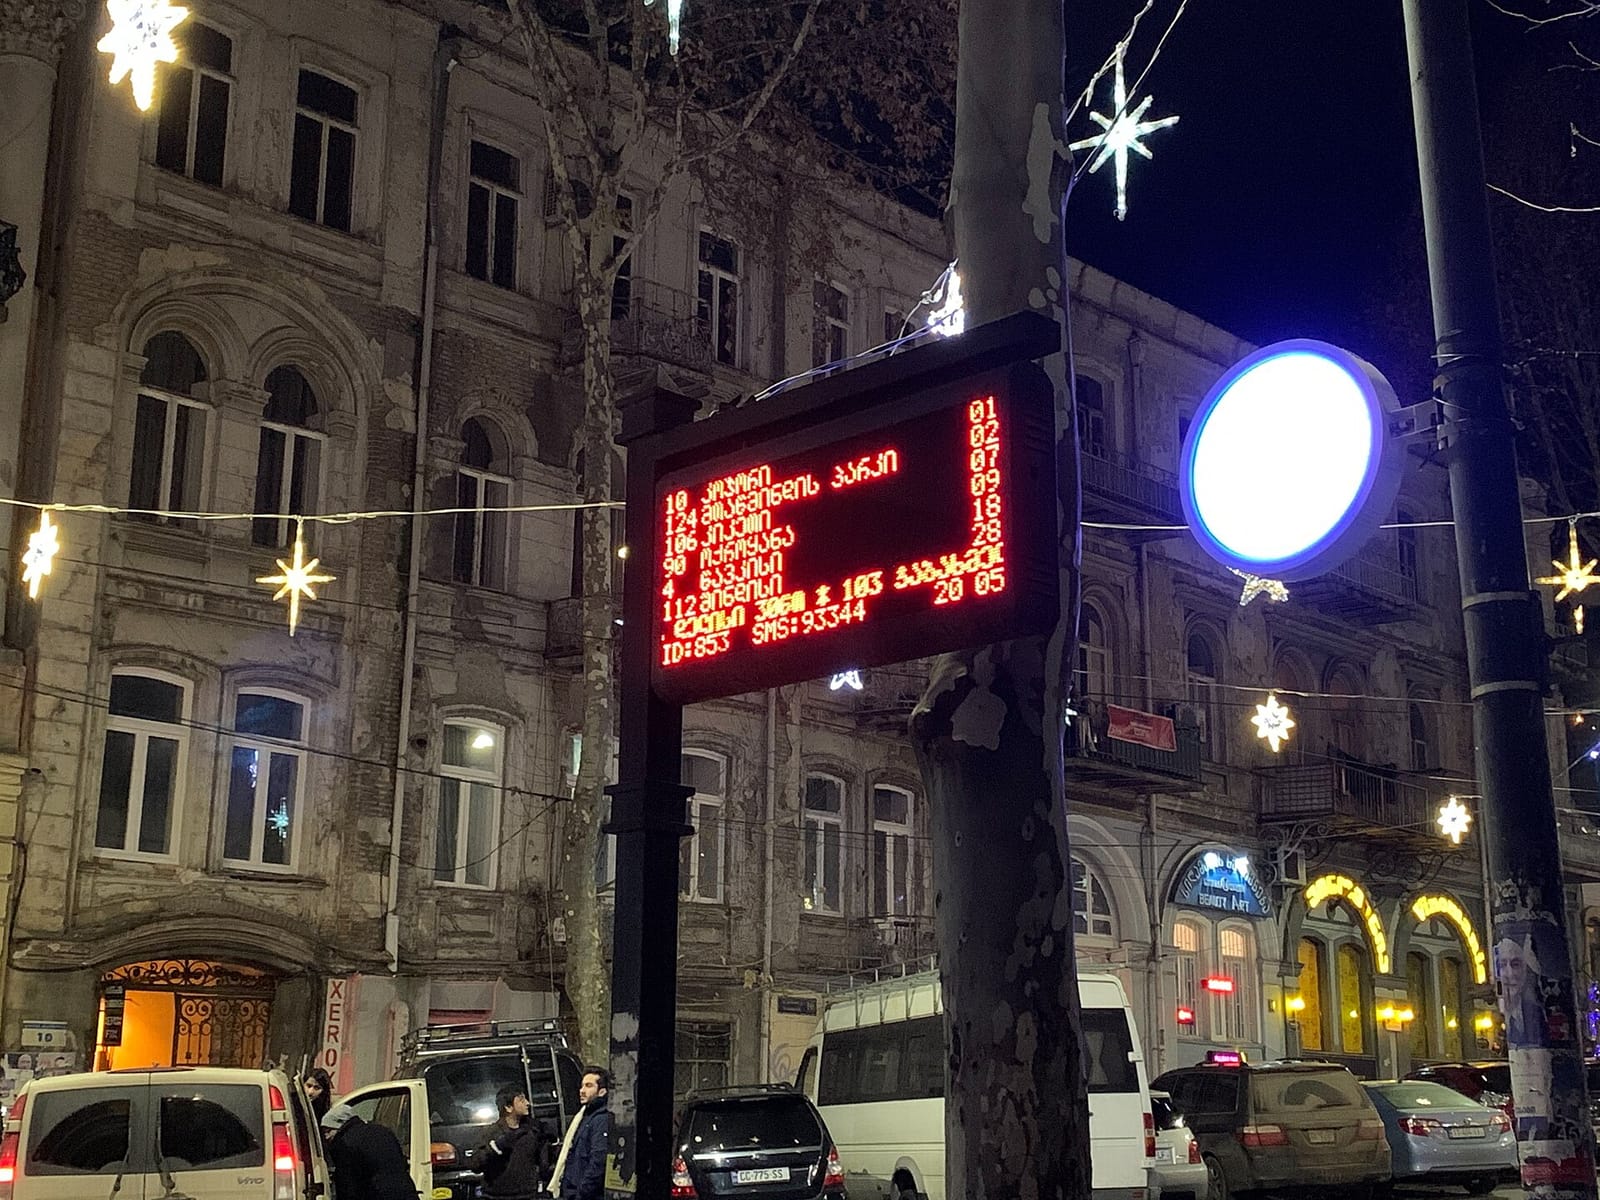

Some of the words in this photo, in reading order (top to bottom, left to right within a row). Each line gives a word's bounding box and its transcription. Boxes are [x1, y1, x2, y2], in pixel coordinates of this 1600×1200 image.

[664, 529, 698, 557] 106
[700, 509, 771, 547] კიკეთი
[970, 443, 1000, 473] 07
[665, 490, 688, 515] 10
[700, 464, 771, 504] კოჯორი
[969, 396, 997, 424] 01
[665, 508, 698, 536] 124
[700, 473, 820, 526] მთაწმინდის
[831, 449, 898, 488] პარკი
[970, 420, 1000, 448] 02
[662, 554, 687, 579] 90
[700, 525, 795, 570] ოქროყანა
[970, 469, 1001, 497] 09
[662, 579, 675, 600] 4
[699, 551, 783, 592] წავკისი
[973, 493, 1002, 522] 18
[663, 594, 697, 622] 112
[699, 573, 783, 613] შინდისი
[971, 518, 1002, 547] 28
[662, 630, 731, 666] ID:853
[751, 600, 867, 645] SMS:93344
[37, 1032, 53, 1043] 10
[325, 981, 345, 1090] XEROX
